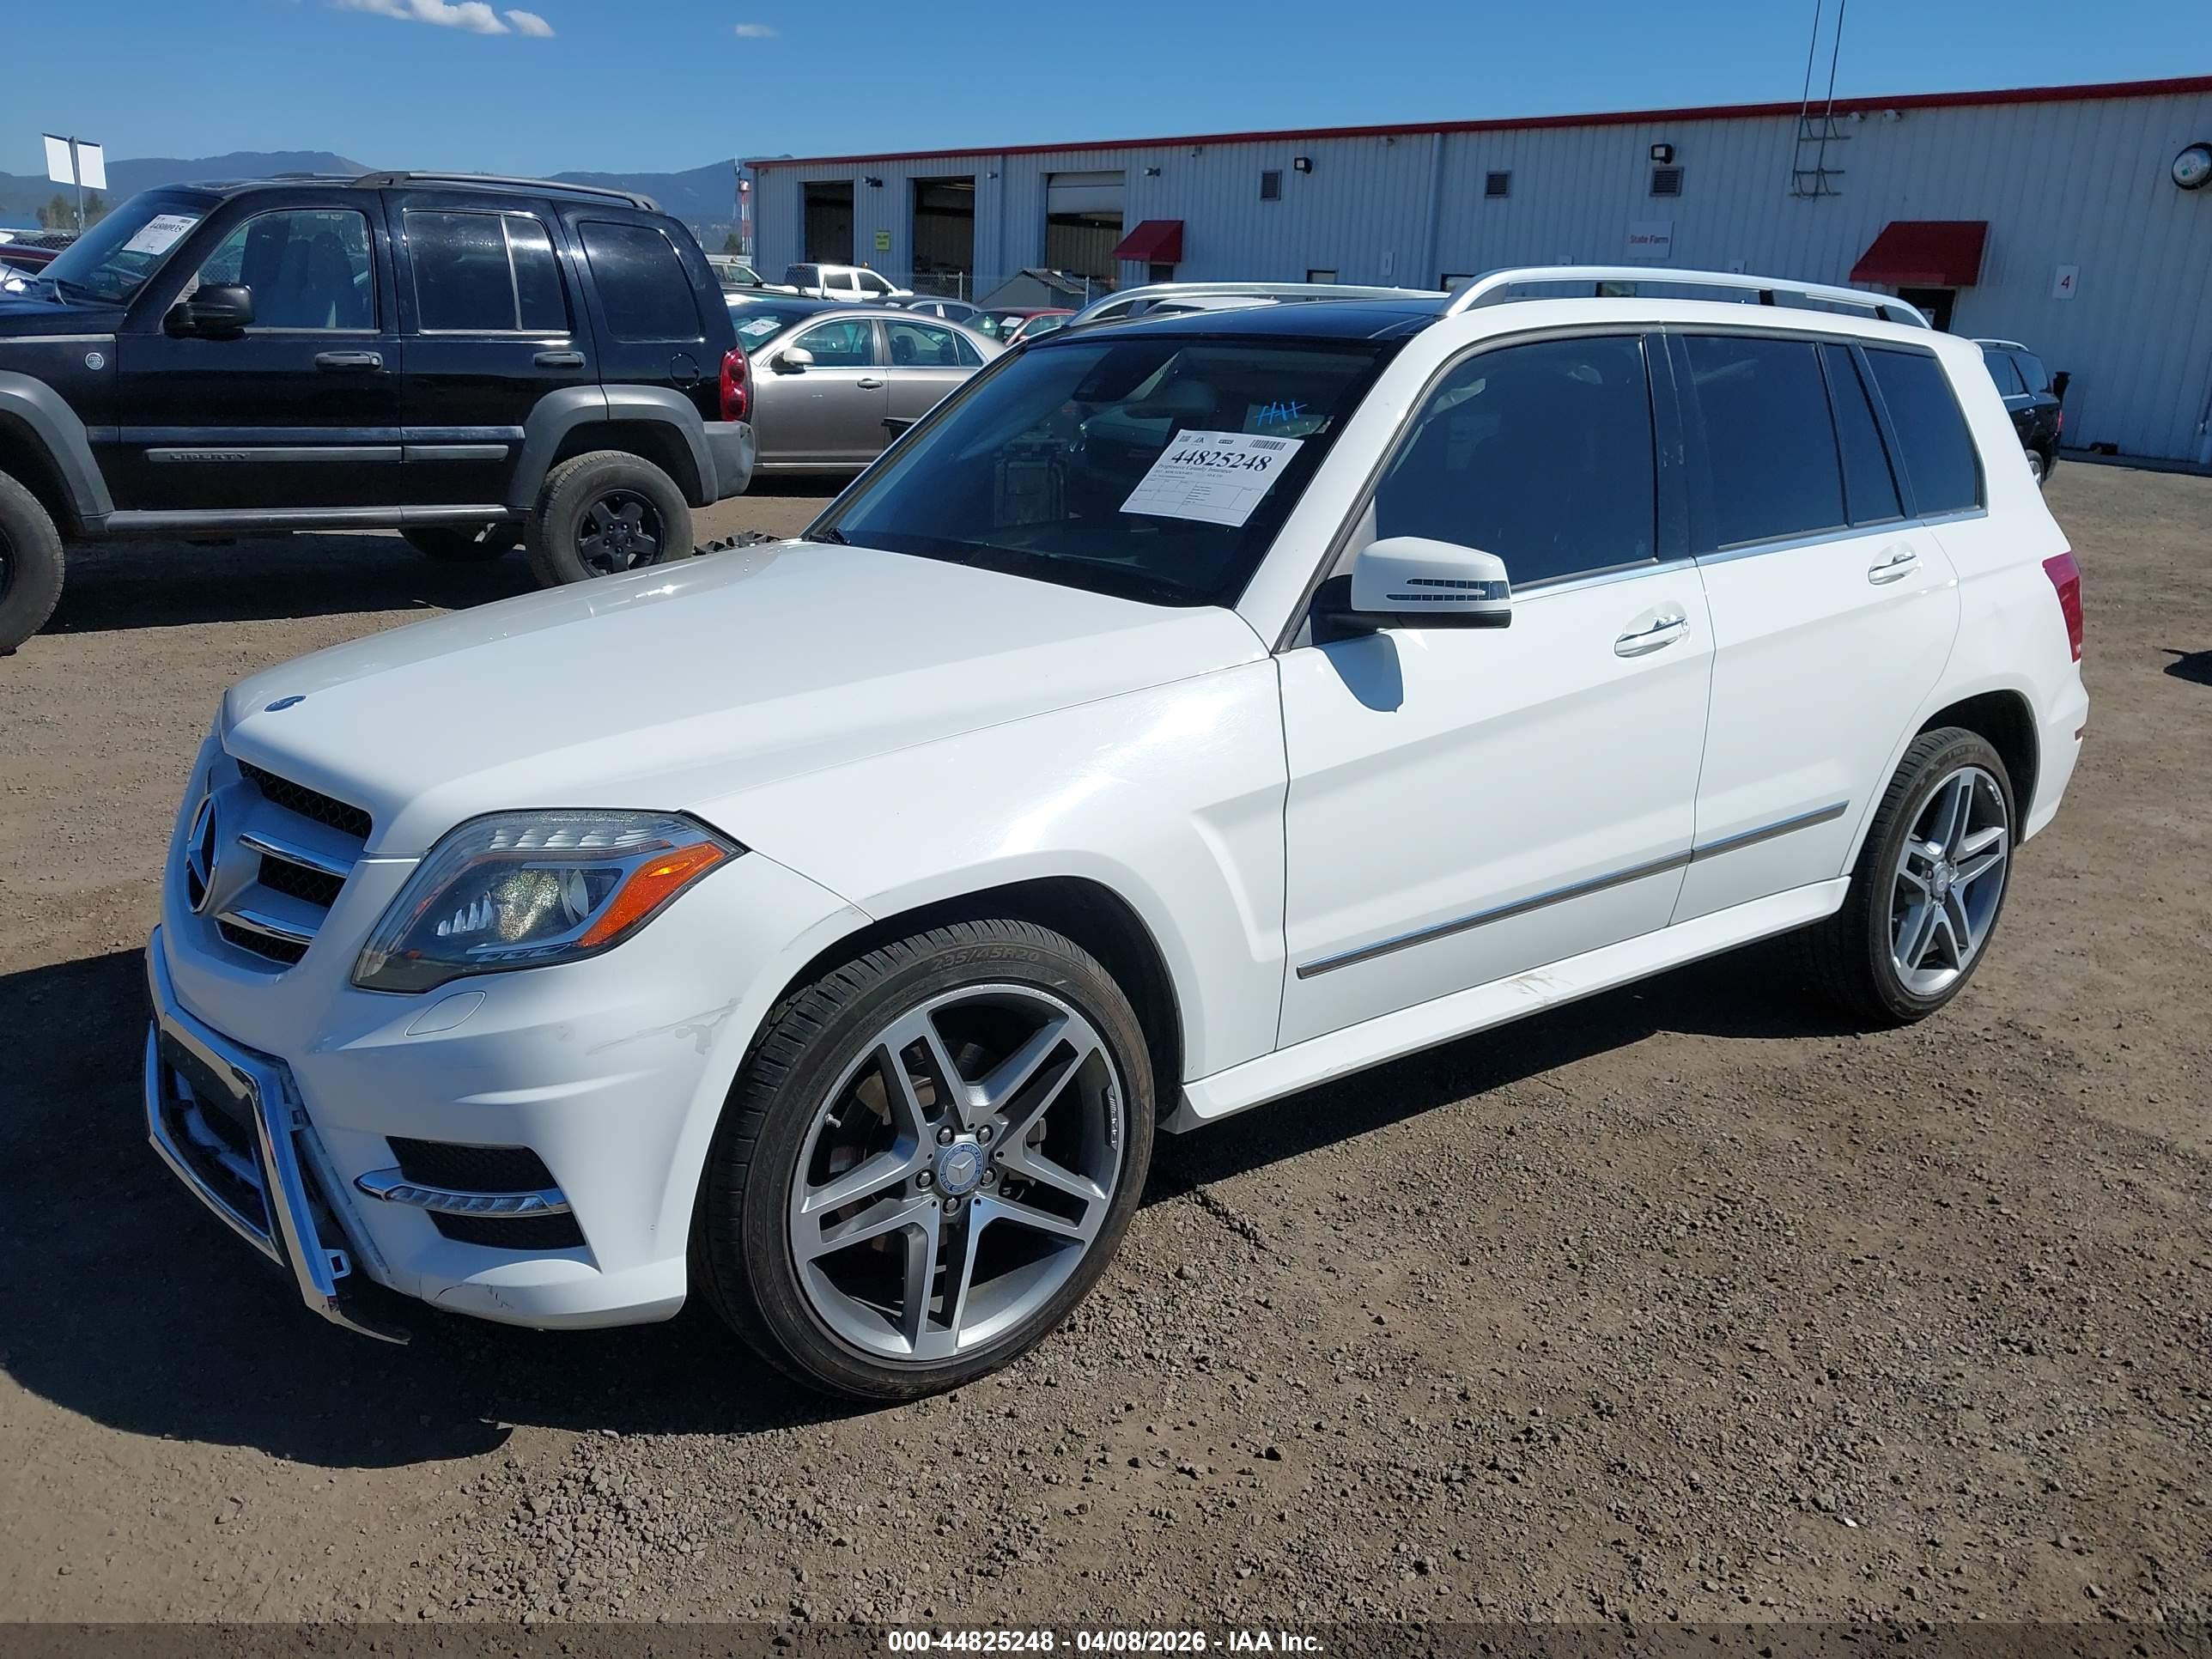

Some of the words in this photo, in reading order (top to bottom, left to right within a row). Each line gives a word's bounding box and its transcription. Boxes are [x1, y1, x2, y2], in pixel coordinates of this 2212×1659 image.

[1630, 234, 1649, 244] State
[1650, 234, 1669, 244] Farm
[2061, 275, 2070, 289] 4
[169, 453, 250, 461] LIBERTY
[1170, 449, 1273, 472] 44825248
[930, 947, 1042, 972] 235/45R20
